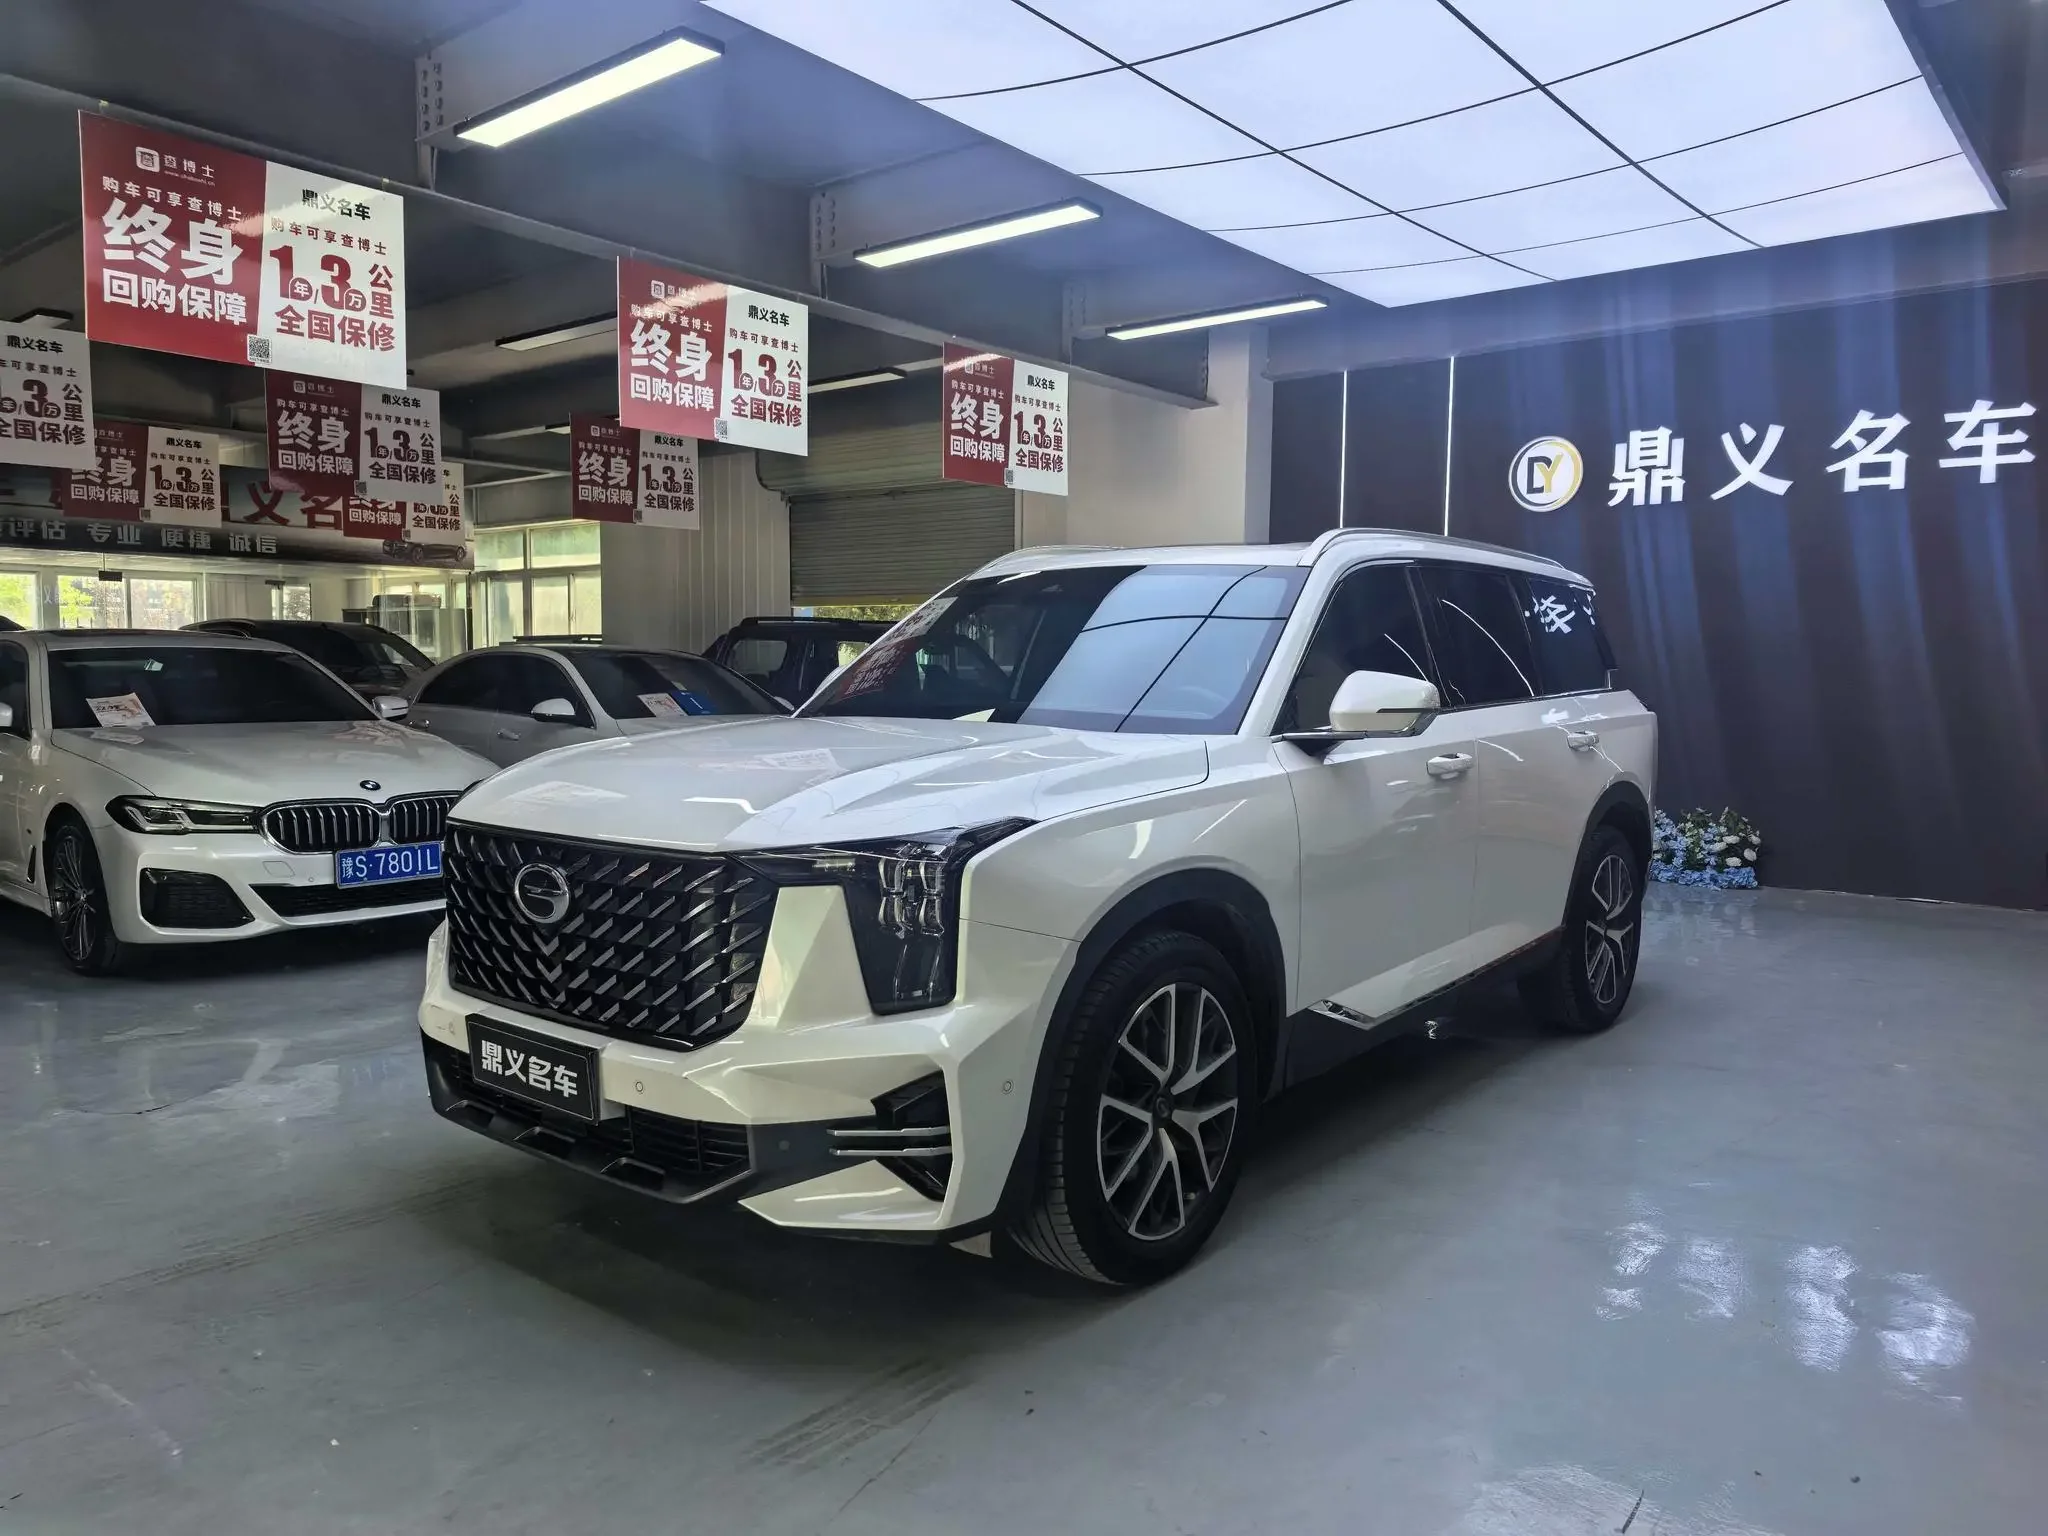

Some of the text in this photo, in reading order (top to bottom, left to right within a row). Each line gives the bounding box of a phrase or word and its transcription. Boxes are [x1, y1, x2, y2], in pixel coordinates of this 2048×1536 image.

[102, 176, 241, 221] 购车可享查博士
[302, 189, 371, 220] 鼎义名车
[102, 197, 243, 285] 终身
[271, 217, 387, 256] 购车可享查博士
[103, 268, 247, 325] 回购保障
[275, 304, 395, 351] 全国保修
[748, 305, 789, 326] 鼎义名车
[7, 335, 63, 355] 鼎义名车
[630, 319, 712, 381] 终身
[729, 328, 798, 352] 购车可享查博士
[630, 373, 714, 411] 回购保障
[951, 379, 1005, 400] 购车可享查博士
[1027, 375, 1055, 391] 鼎义名车
[276, 398, 349, 416] 购车可享查博士
[381, 393, 421, 408] 鼎义名车
[731, 394, 802, 427] 全国保修
[950, 391, 1004, 440] 终身
[277, 410, 350, 454] 终身
[278, 449, 354, 476] 回购保障
[950, 435, 1006, 463] 回购保障
[1016, 448, 1064, 473] 全国保修
[1607, 399, 2036, 507] 鼎义名车
[369, 462, 436, 484] 全国保修
[578, 451, 631, 487] 终身
[71, 484, 139, 504] 回购保障
[153, 492, 216, 511] 全国保修
[579, 484, 633, 505] 回购保障
[644, 493, 695, 512] 全国保修
[349, 508, 401, 526] 回购保障
[412, 515, 460, 531] 全国保修
[0, 517, 277, 554] 评估 专业 便捷 诚信
[481, 1040, 578, 1098] 鼎义名车
